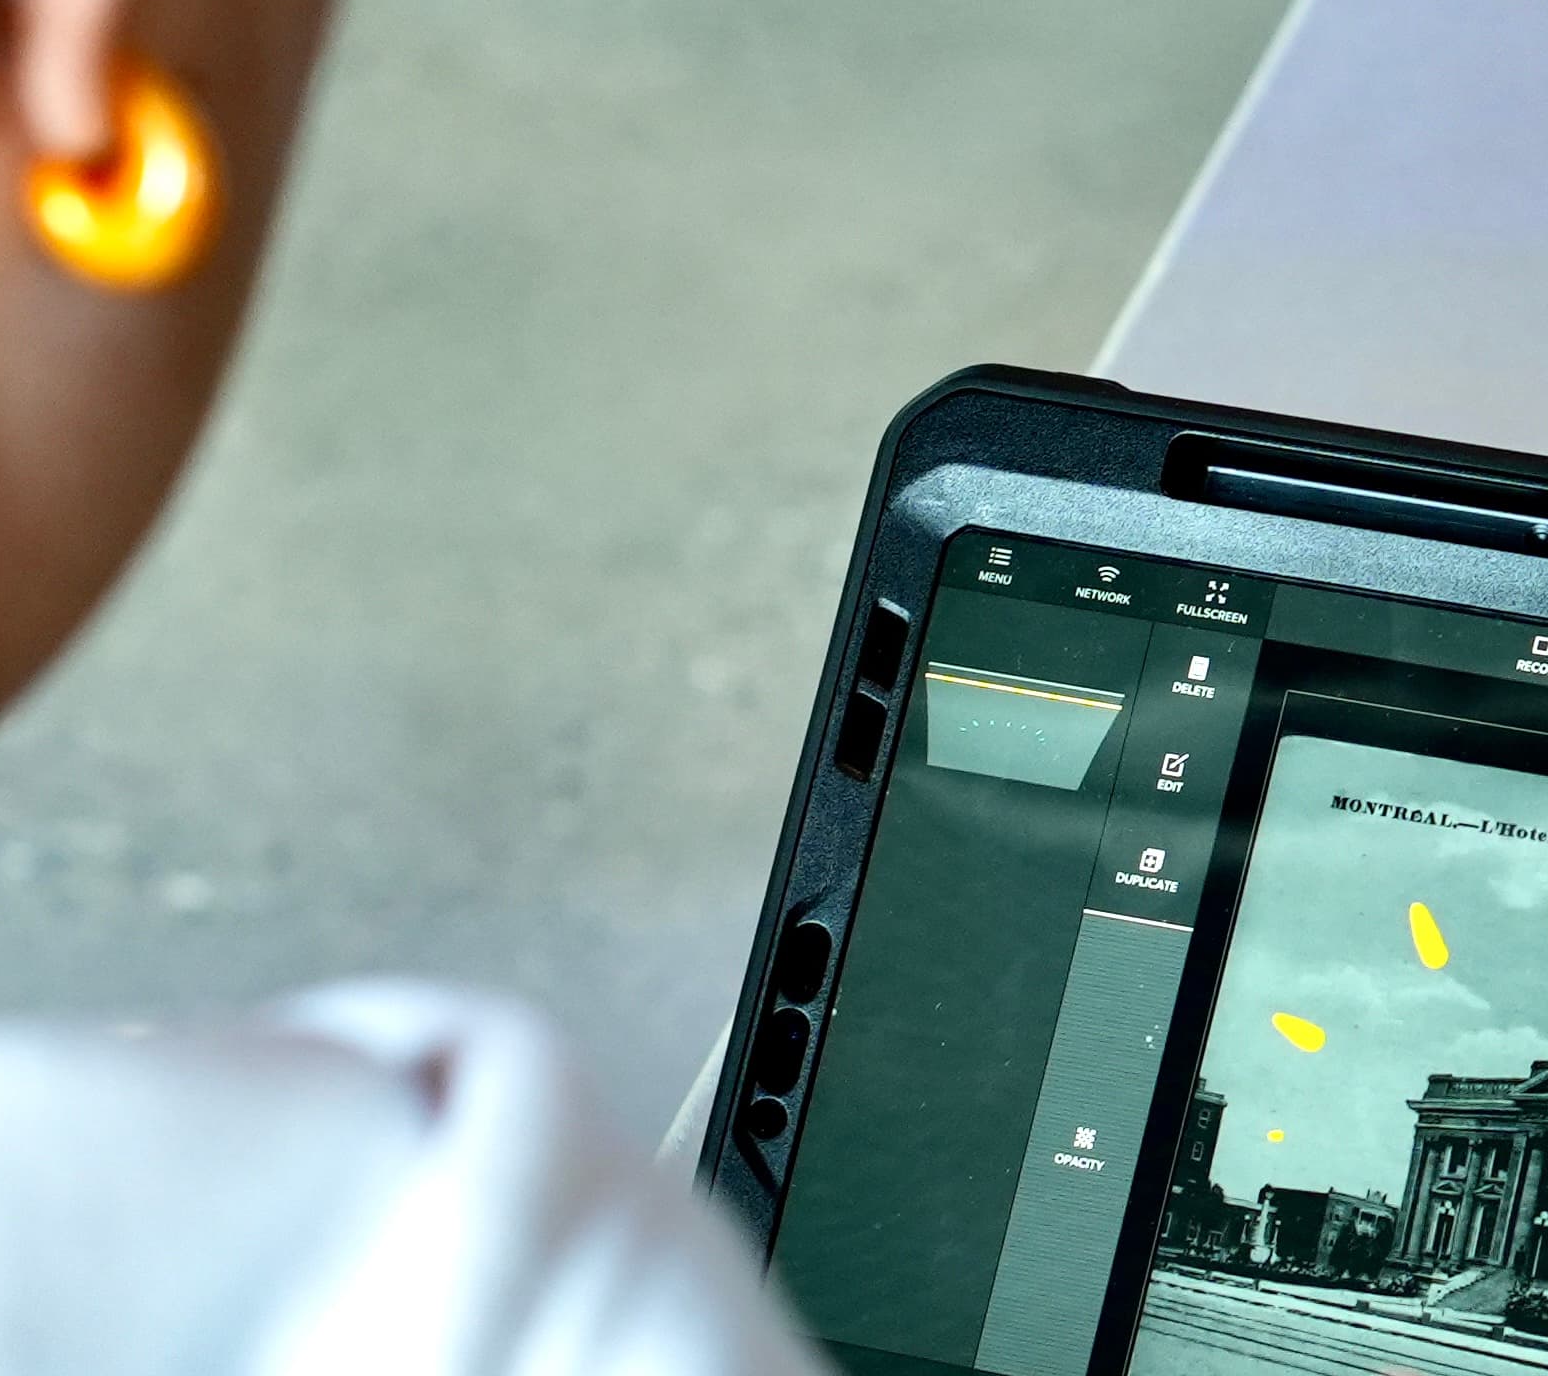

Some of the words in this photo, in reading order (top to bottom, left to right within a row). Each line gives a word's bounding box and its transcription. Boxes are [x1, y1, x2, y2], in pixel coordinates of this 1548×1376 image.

[977, 570, 1013, 586] MENU
[1075, 586, 1132, 606] NETWORK
[1176, 603, 1249, 625] FULLSCREEN
[1171, 681, 1216, 699] DELETE
[1156, 778, 1185, 793] EDIT
[1115, 871, 1179, 893] DUPLICATE
[1053, 1152, 1106, 1172] OPACITY
